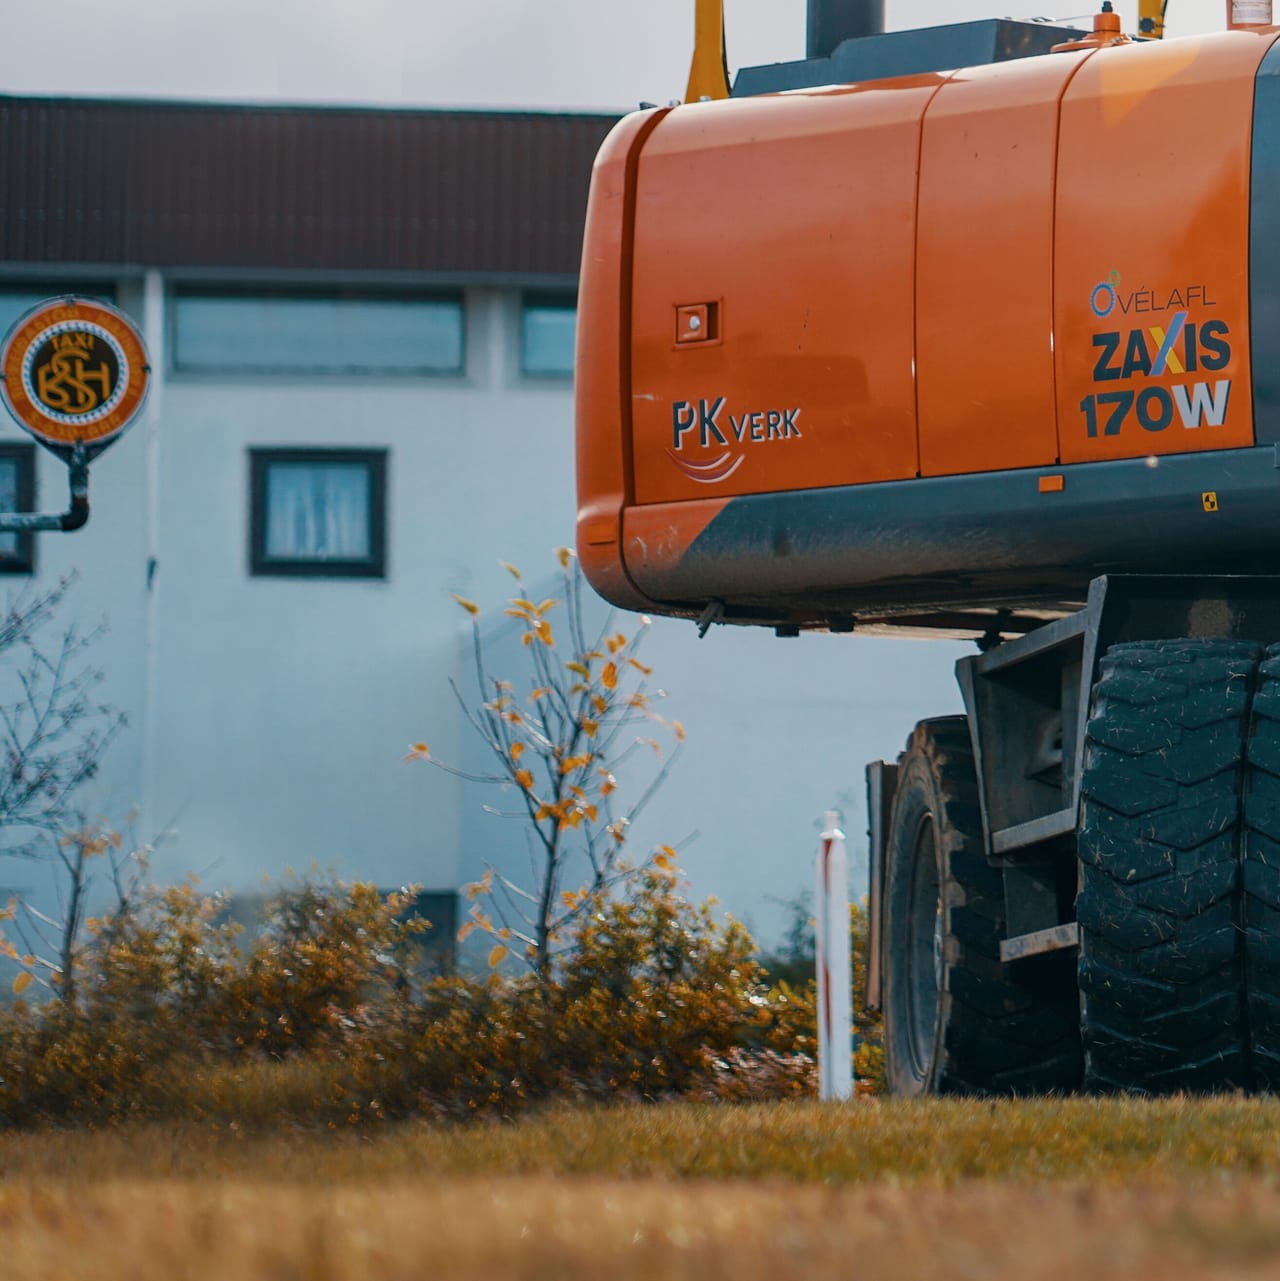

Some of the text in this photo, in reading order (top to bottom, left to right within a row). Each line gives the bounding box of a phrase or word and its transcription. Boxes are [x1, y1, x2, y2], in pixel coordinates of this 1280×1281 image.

[49, 332, 95, 350] TAXI
[1092, 311, 1231, 382] ZAXIS
[673, 396, 802, 451] PK VERK
[1079, 379, 1232, 438] 170W
